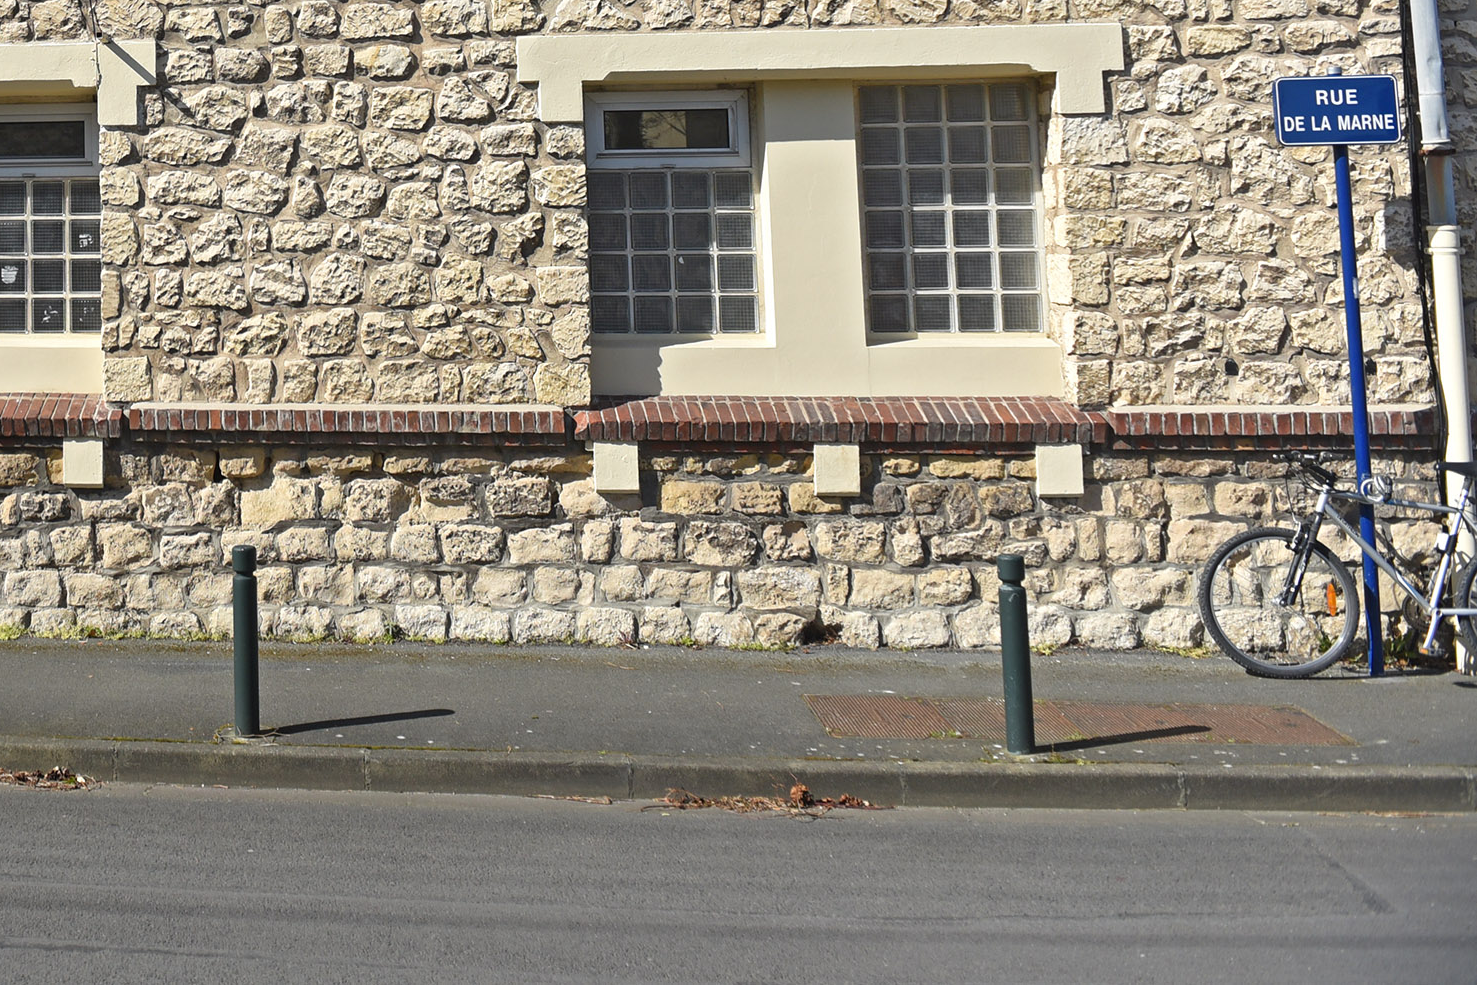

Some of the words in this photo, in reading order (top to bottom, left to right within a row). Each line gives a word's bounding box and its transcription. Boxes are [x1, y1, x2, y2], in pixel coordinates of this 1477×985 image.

[1315, 88, 1359, 106] RUE
[1284, 116, 1306, 132] DE
[1311, 115, 1332, 131] LA
[1338, 113, 1395, 131] MARNE
